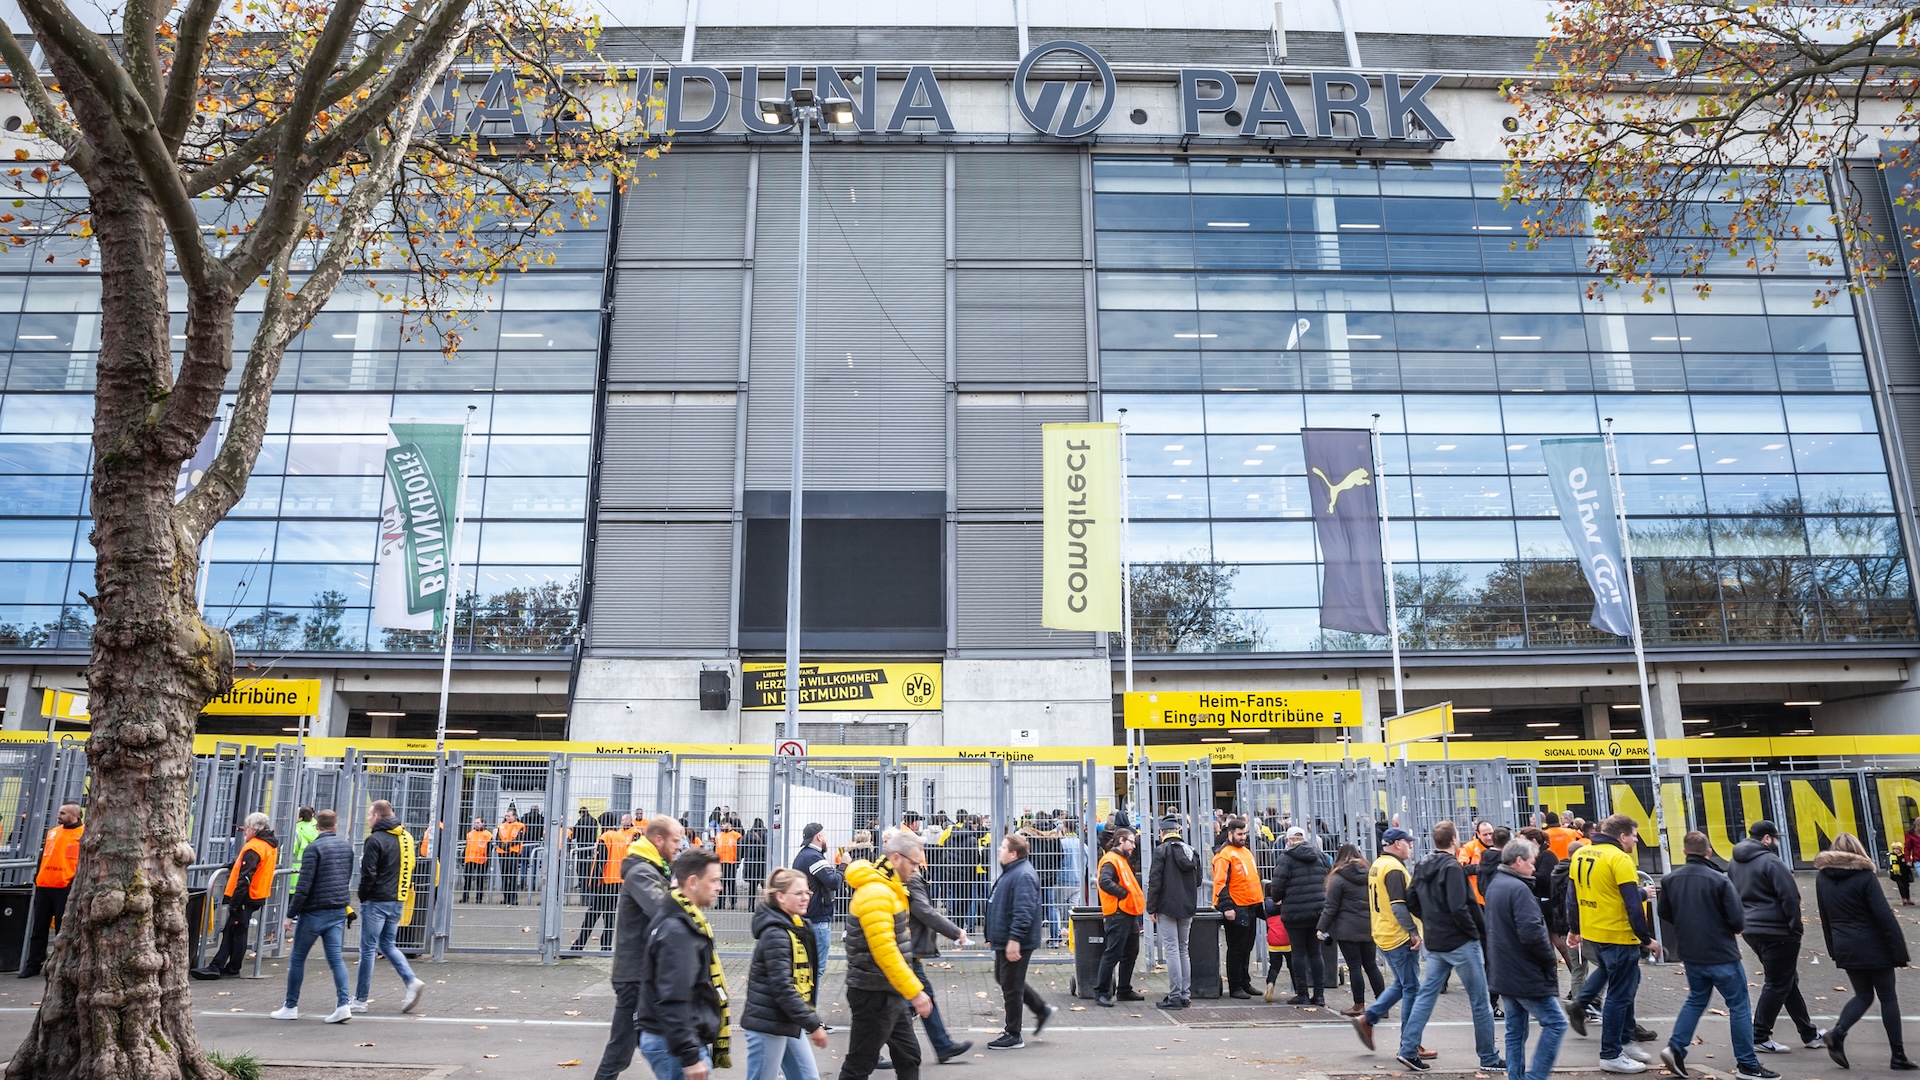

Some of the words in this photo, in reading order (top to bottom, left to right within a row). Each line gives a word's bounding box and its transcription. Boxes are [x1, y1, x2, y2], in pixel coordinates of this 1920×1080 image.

[635, 66, 956, 133] IDUNA
[1180, 69, 1455, 141] PARK
[755, 678, 806, 690] HERZLH
[808, 672, 879, 687] WILLKOMMEN
[906, 676, 932, 696] BVB
[212, 688, 298, 704] rdtribüne
[763, 691, 777, 705] IN
[780, 685, 864, 703] DRTMUND!
[913, 695, 924, 703] 09
[1199, 694, 1288, 708] Heim-Fans:
[1164, 710, 1226, 726] Eingang
[1230, 709, 1324, 723] Nordtribüne
[958, 751, 986, 759] Nord
[989, 751, 1034, 761] Tribüne
[1544, 749, 1574, 757] SIGNAL
[1578, 748, 1605, 756] IDUNA
[1626, 747, 1649, 755] PARK
[1577, 856, 1596, 890] 17
